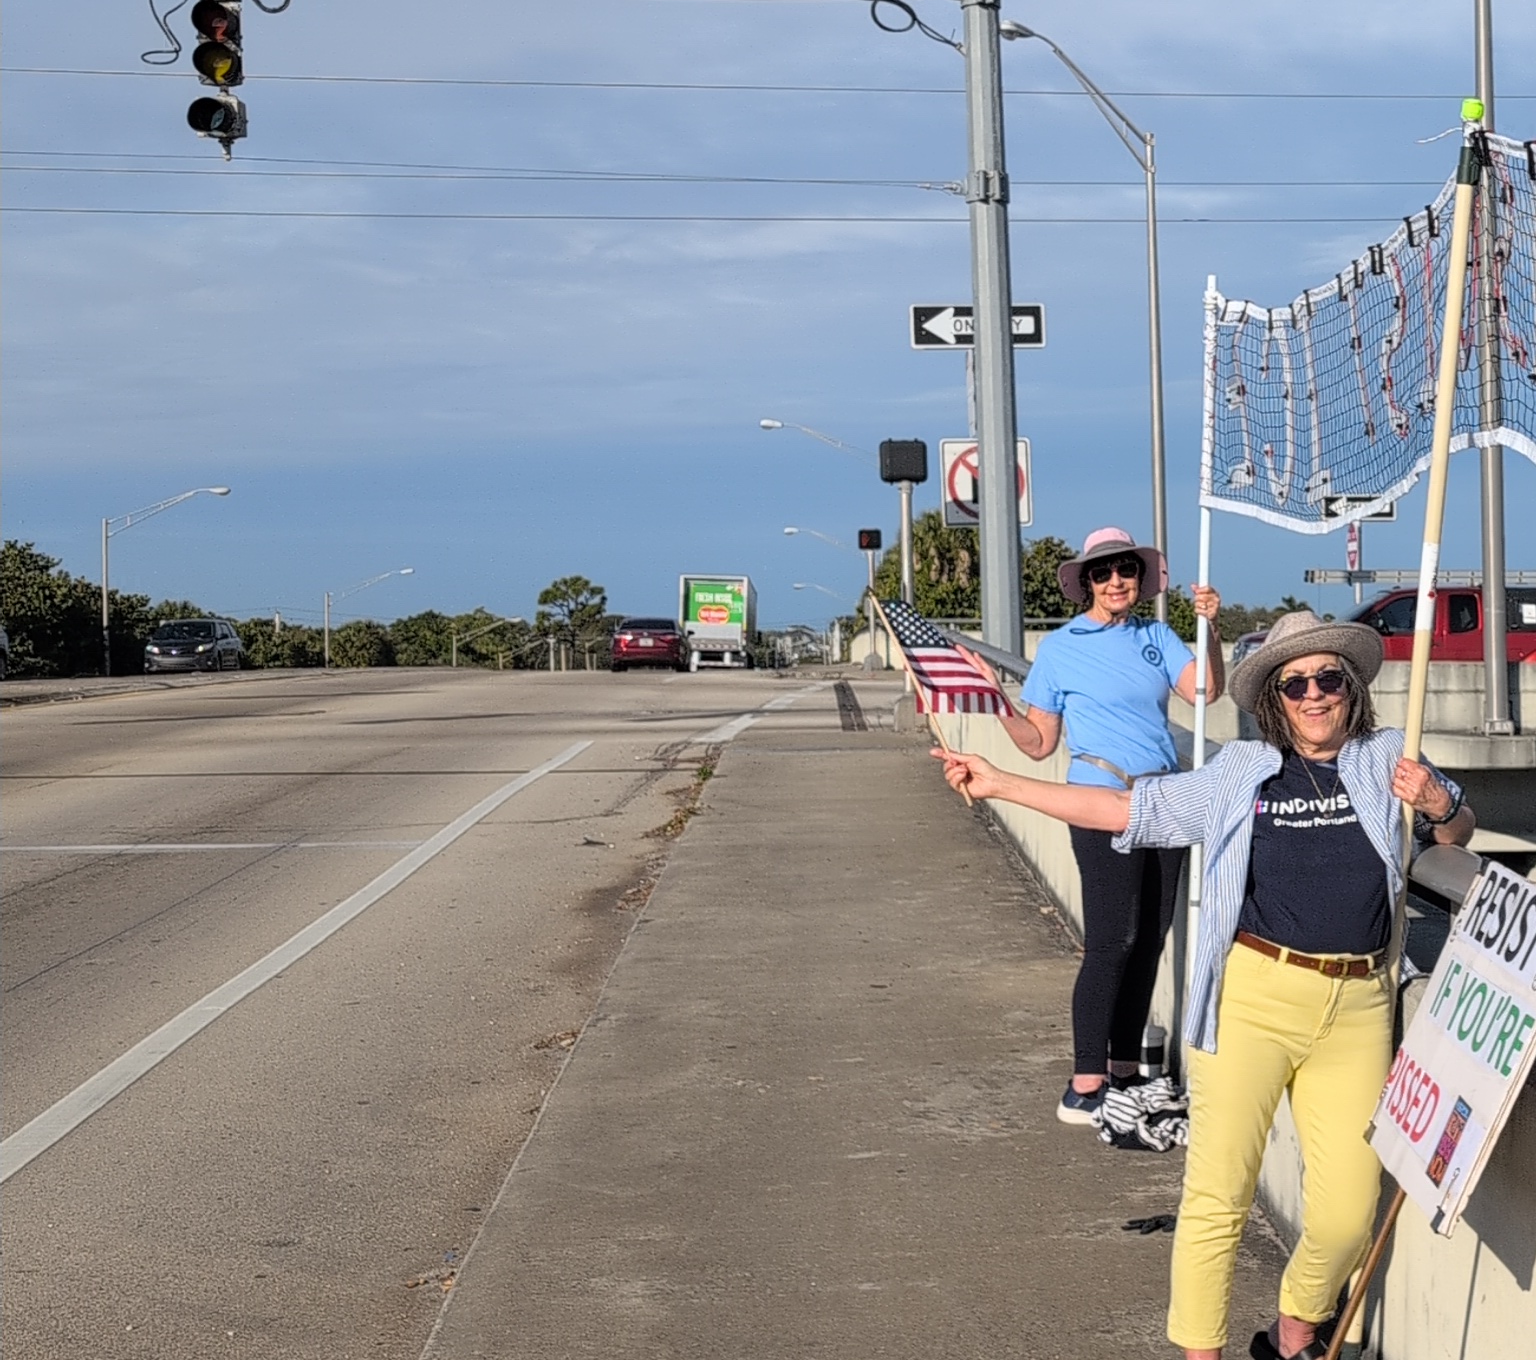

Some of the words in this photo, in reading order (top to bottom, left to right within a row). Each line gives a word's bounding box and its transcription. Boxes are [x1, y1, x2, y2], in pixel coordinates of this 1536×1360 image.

[1271, 793, 1350, 815] INDIVIS
[1273, 817, 1313, 828] Greater
[1314, 813, 1358, 827] Portland
[1429, 959, 1462, 1018] IF
[1446, 972, 1536, 1078] YOU'RE
[1386, 1047, 1441, 1143] PISSED
